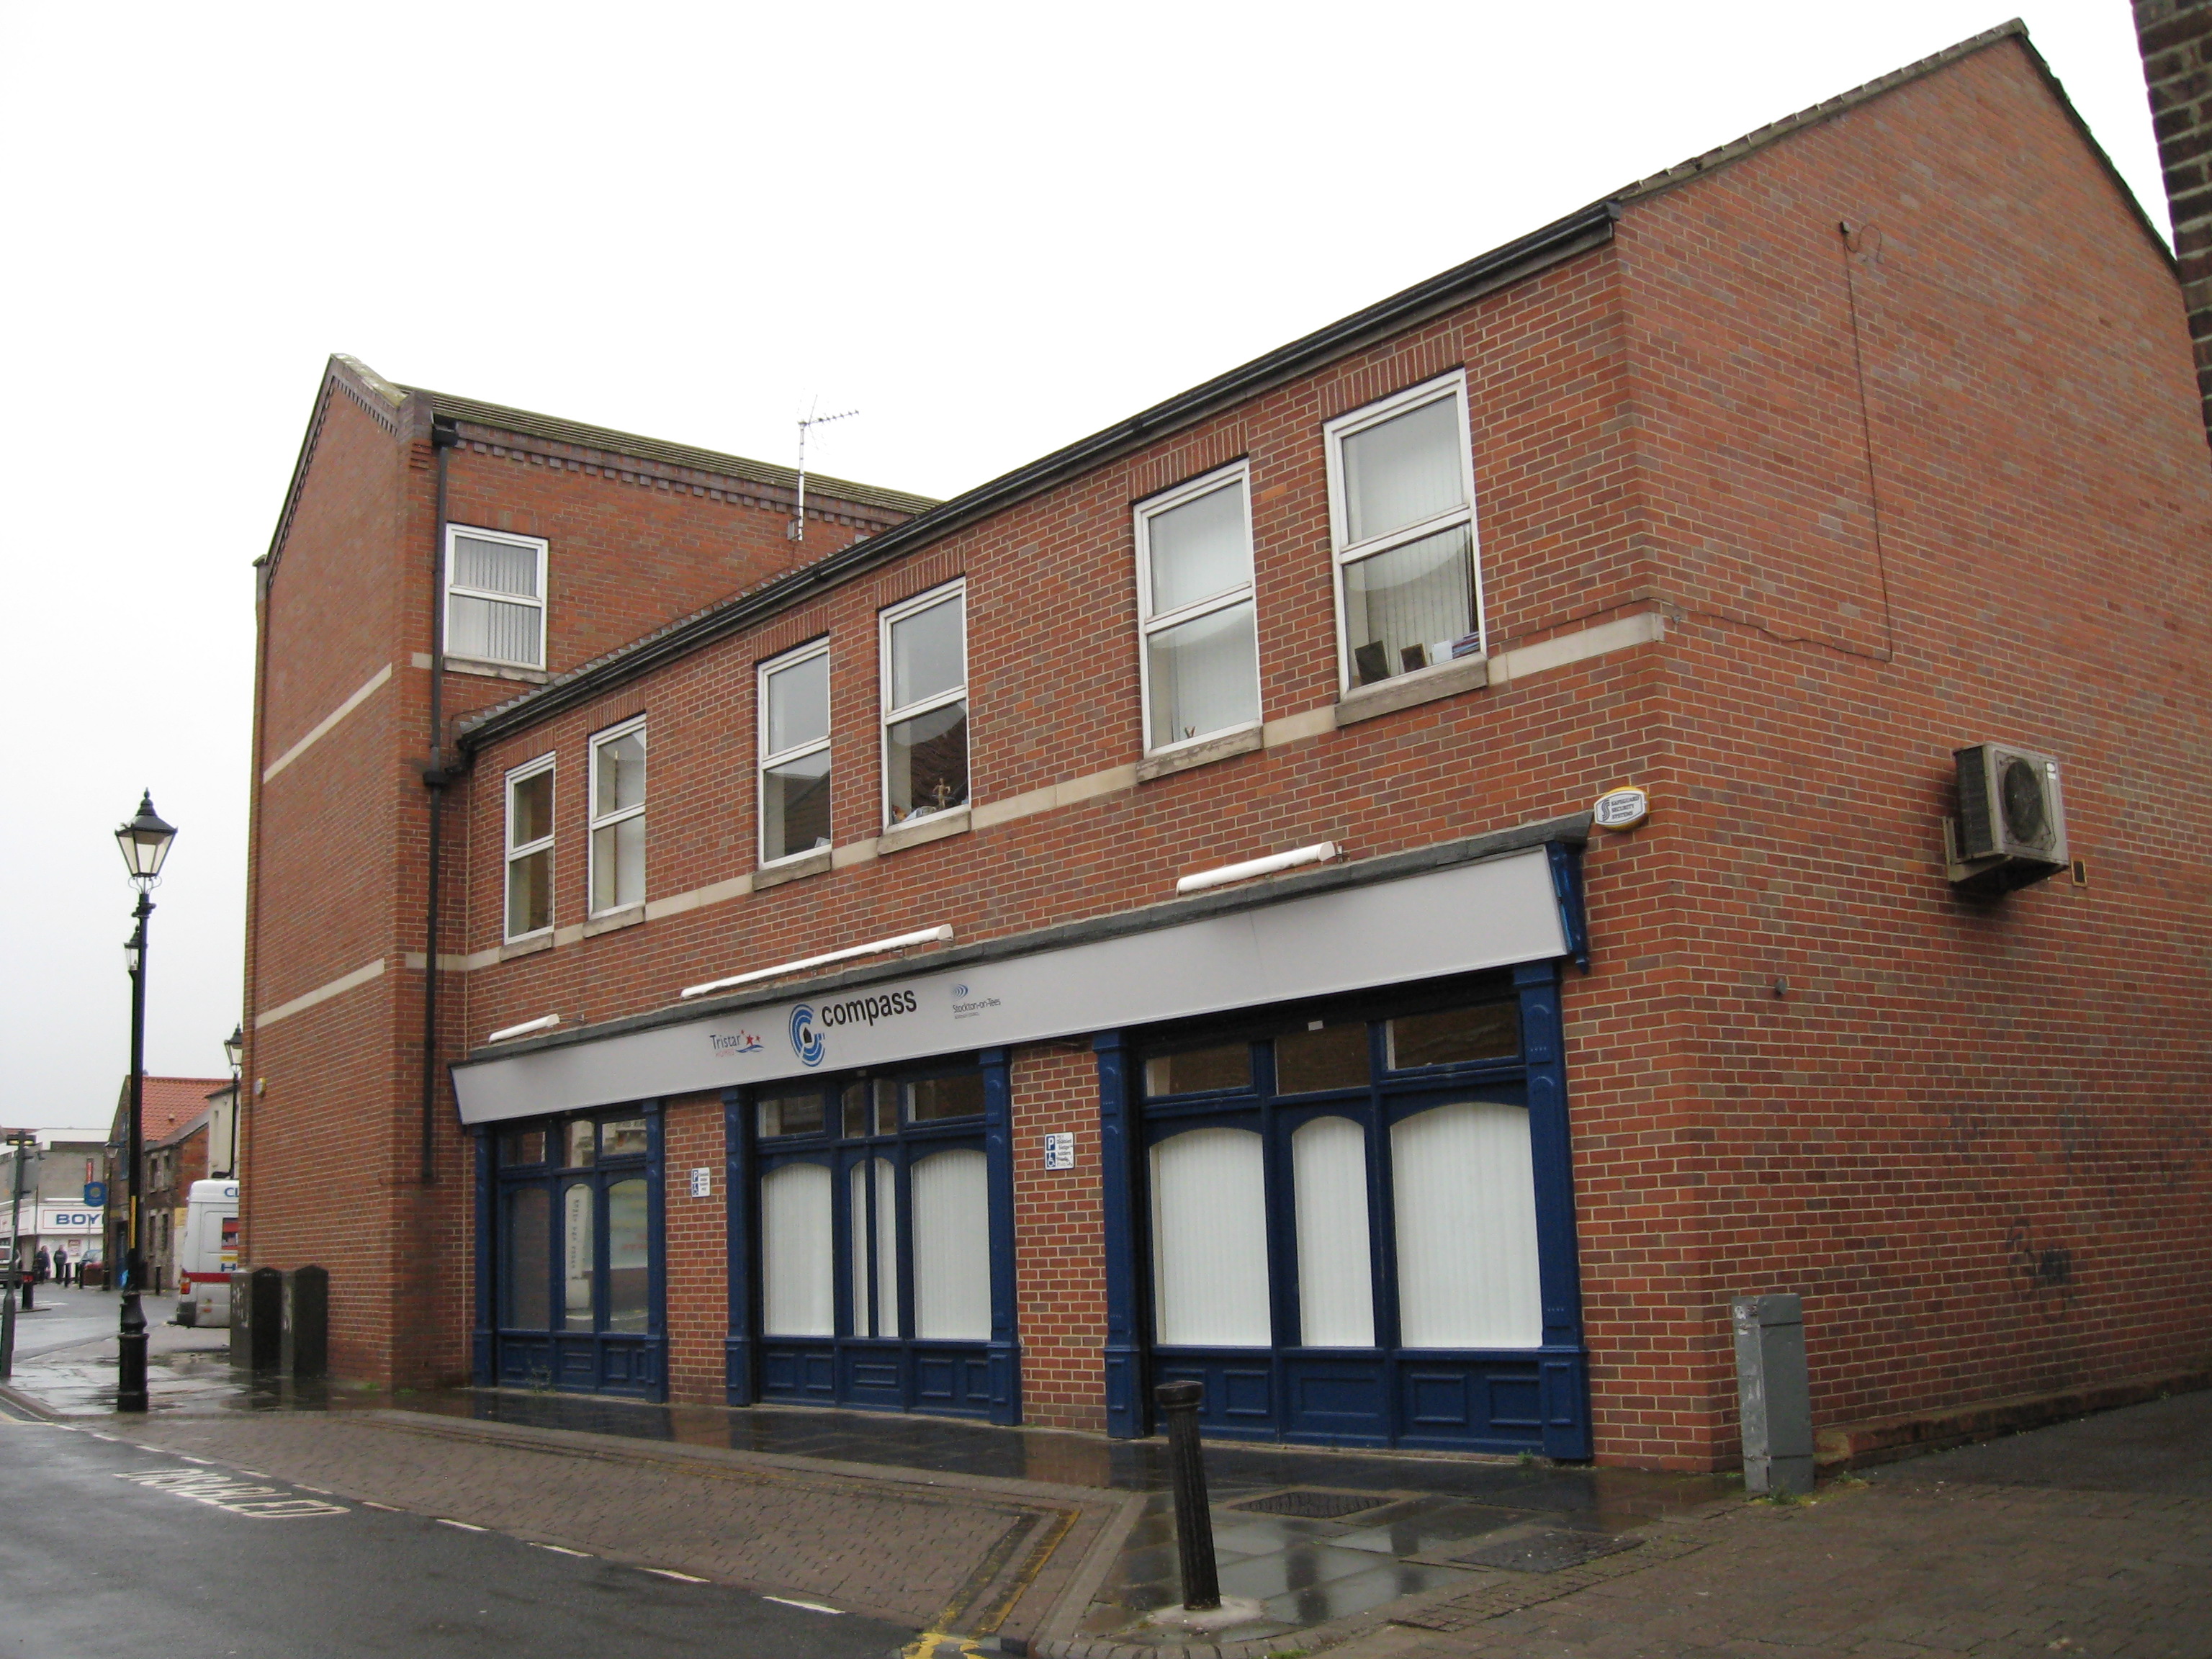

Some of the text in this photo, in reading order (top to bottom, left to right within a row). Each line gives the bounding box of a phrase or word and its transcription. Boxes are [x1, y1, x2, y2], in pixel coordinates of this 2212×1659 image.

[822, 990, 917, 1027] compass
[953, 998, 1001, 1013] Stockton-on-Tees
[709, 1035, 740, 1050] Tristar
[56, 1214, 104, 1224] BOY
[112, 1468, 351, 1519] DISABLED
